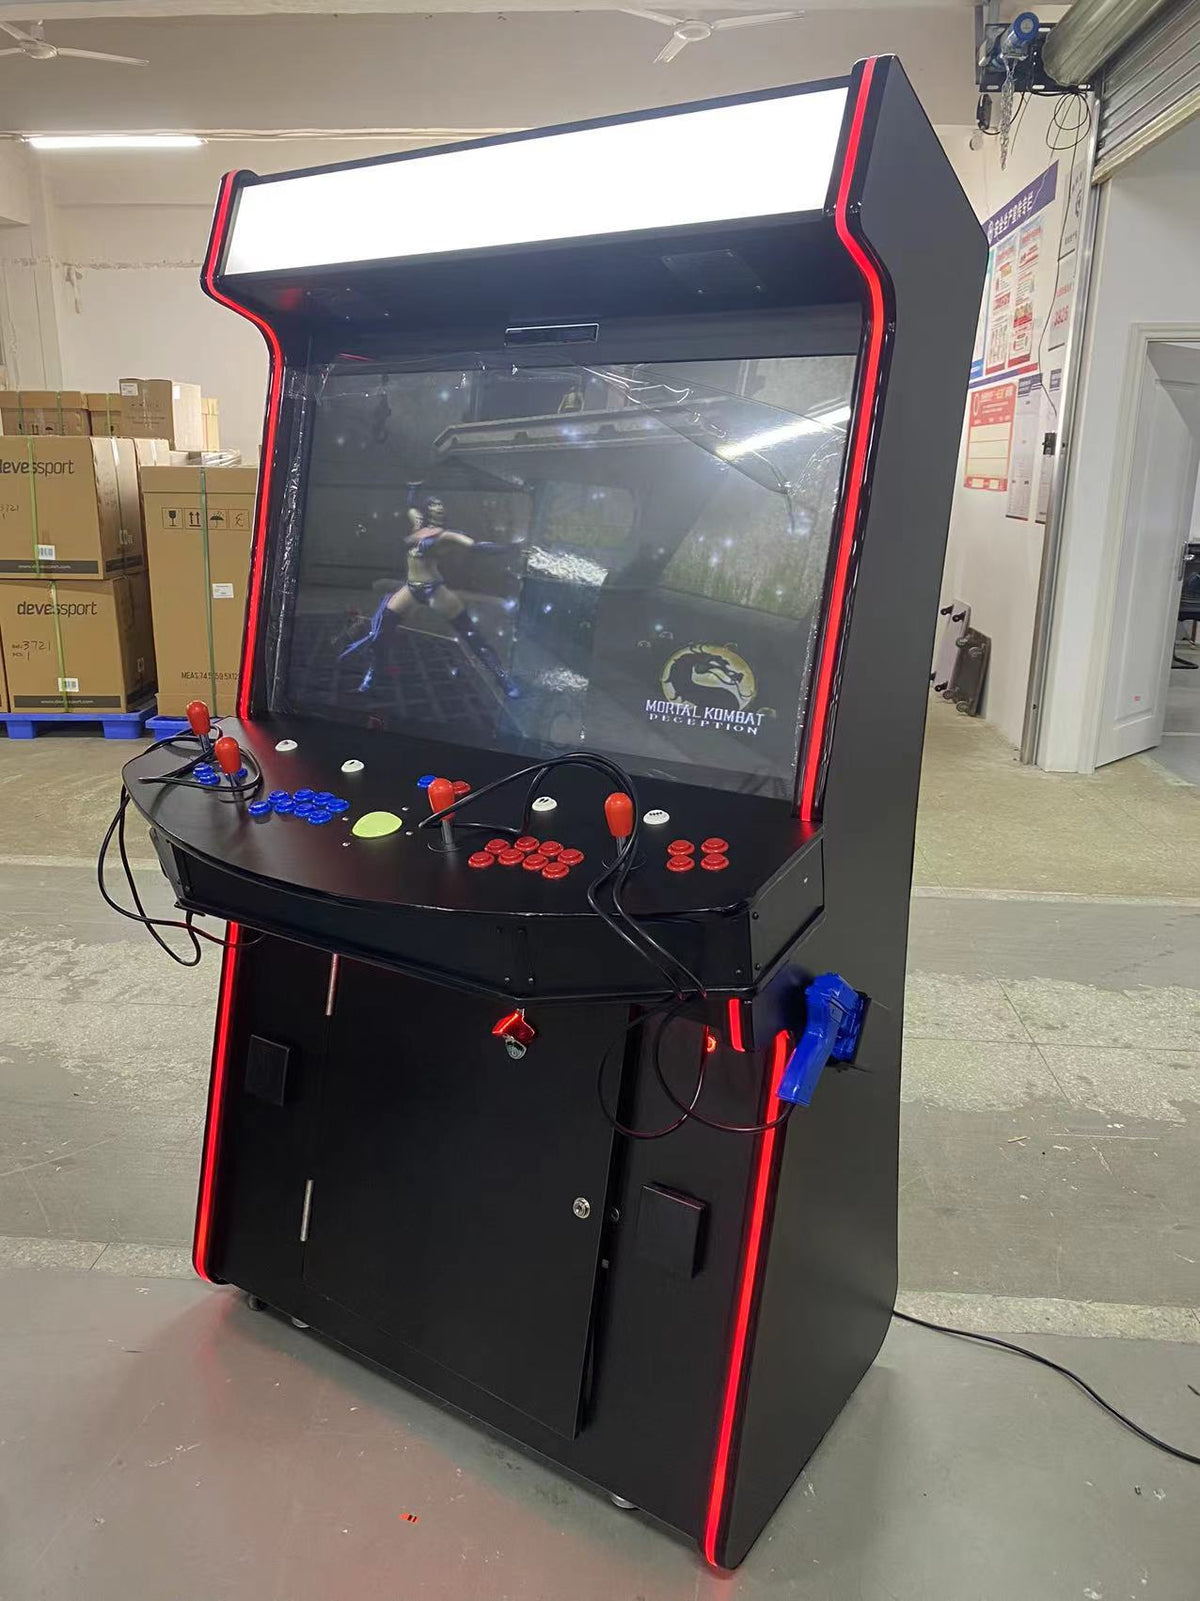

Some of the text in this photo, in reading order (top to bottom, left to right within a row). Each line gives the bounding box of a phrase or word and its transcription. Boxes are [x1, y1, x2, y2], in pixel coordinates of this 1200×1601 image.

[17, 601, 98, 618] devessport
[22, 640, 51, 651] 3721
[645, 699, 765, 726] MORTAL KOMBAT
